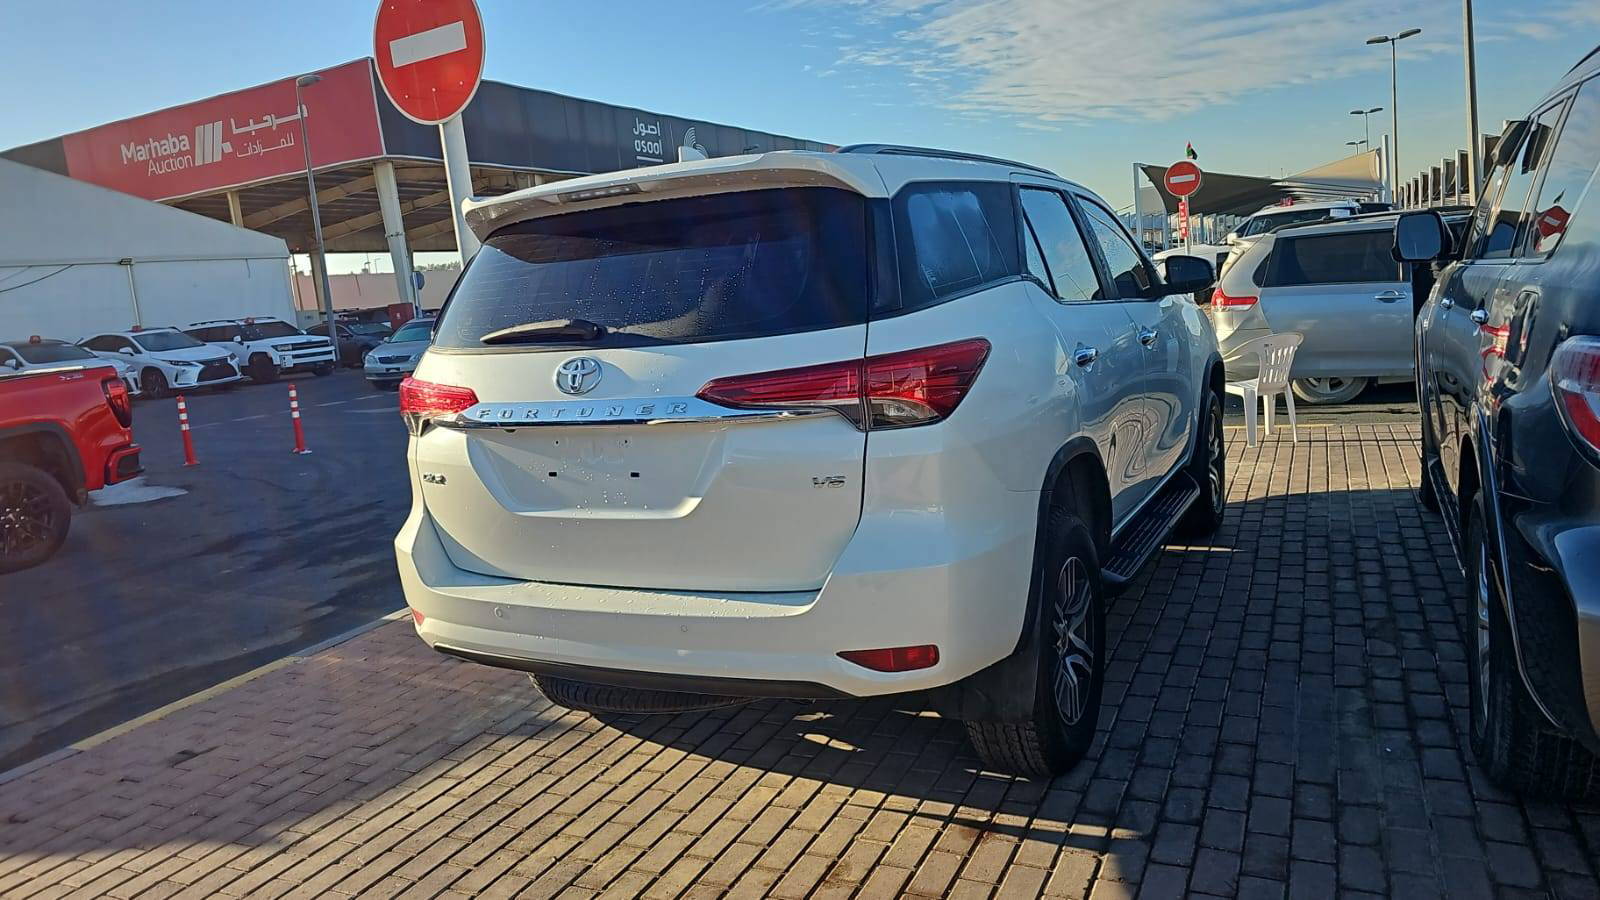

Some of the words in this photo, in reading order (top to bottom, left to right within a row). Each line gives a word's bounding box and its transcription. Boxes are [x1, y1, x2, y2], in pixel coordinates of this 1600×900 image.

[120, 133, 190, 164] Marhaba
[148, 154, 192, 176] Auction
[476, 402, 687, 419] FORTUNER
